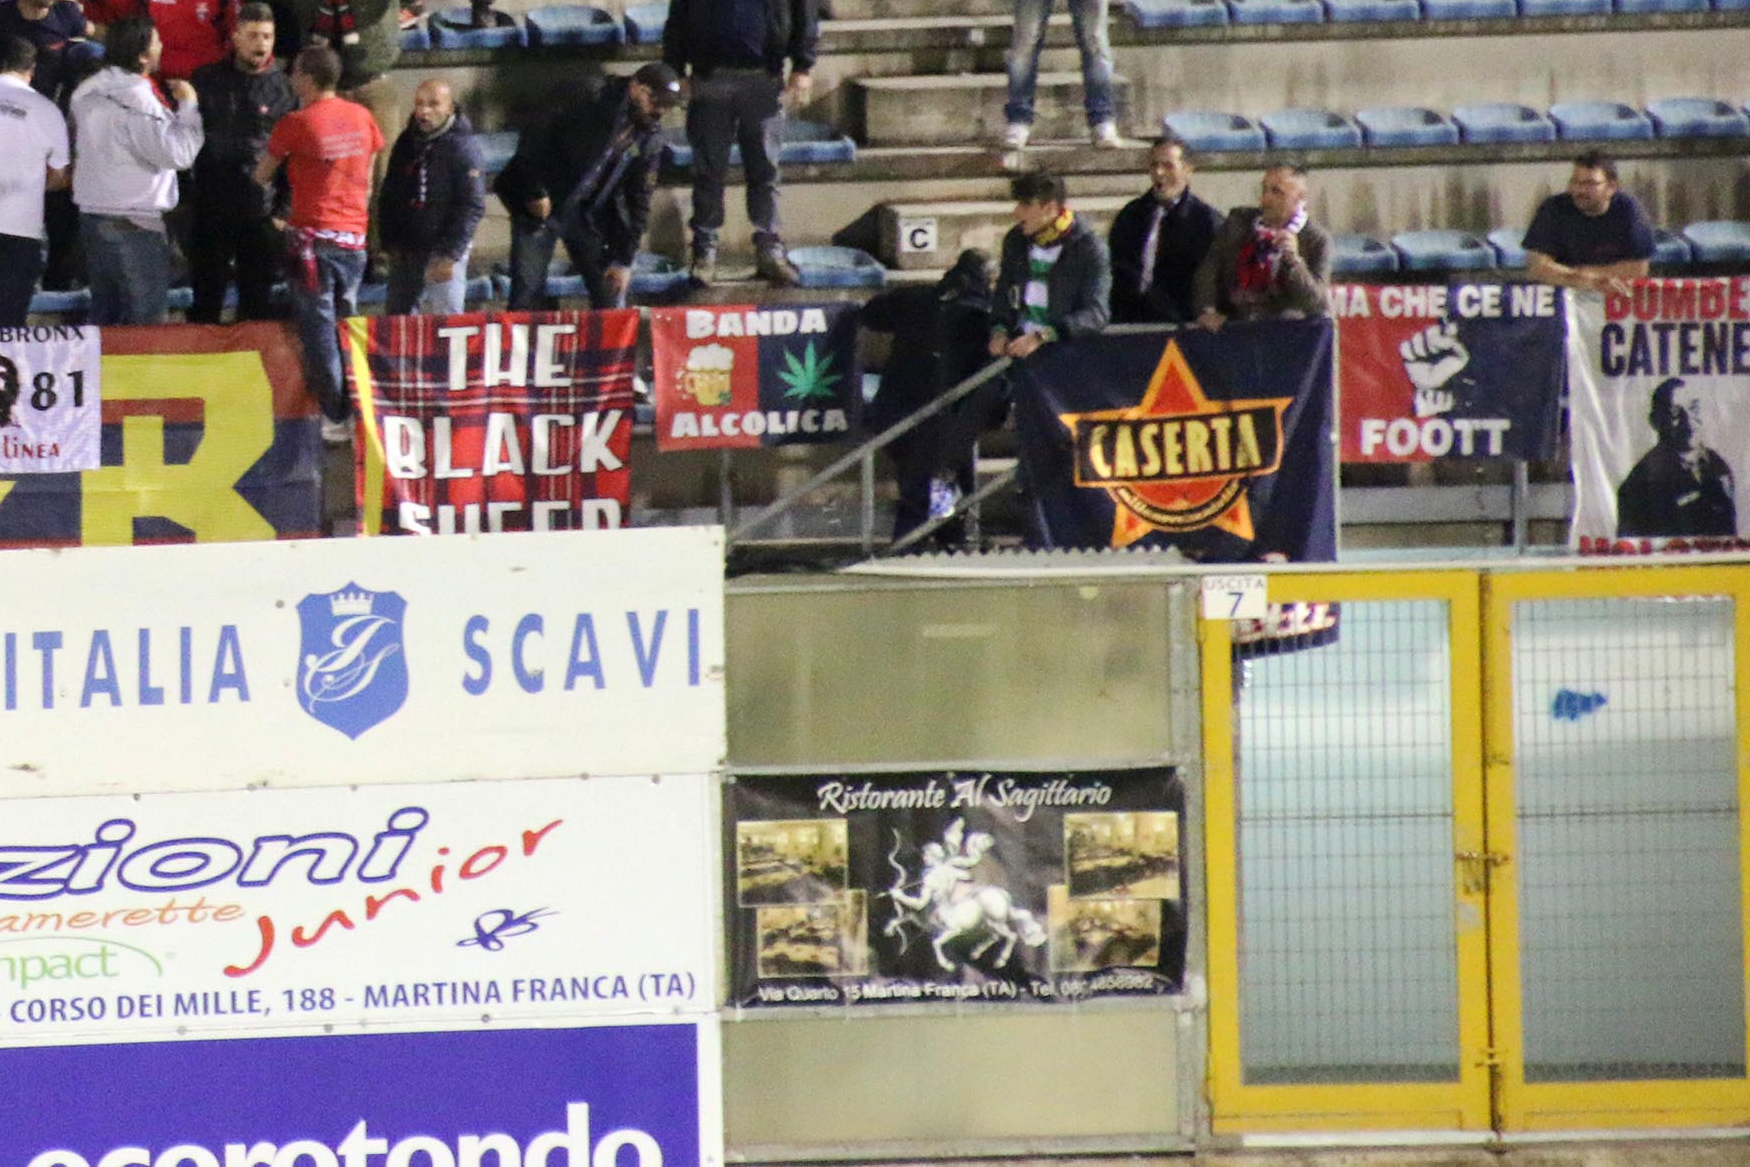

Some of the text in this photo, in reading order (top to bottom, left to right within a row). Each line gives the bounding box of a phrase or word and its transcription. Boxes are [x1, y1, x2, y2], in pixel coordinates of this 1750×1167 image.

[910, 228, 929, 249] C
[1325, 285, 1556, 319] MA CHE CE NE
[0, 325, 85, 343] BRONX
[686, 309, 827, 339] BANDA
[439, 323, 576, 391] THE
[1601, 321, 1750, 377] CATENE
[384, 409, 623, 480] BLACK
[671, 409, 848, 438] ALCOLICA
[1360, 418, 1512, 456] FOOTT
[1090, 413, 1262, 479] CASERTA
[1227, 591, 1244, 616] 7
[5, 624, 251, 711] ITALIA
[462, 608, 700, 696] SCAVI
[817, 774, 1113, 822] Ristorante Al Sagittario
[10, 997, 107, 1024] CORSO
[117, 995, 164, 1019] DEI
[173, 989, 272, 1019] MILLE,
[283, 987, 336, 1013] 188
[363, 980, 503, 1010] MARTINA
[511, 975, 630, 1002] FRANCA
[638, 971, 696, 1002] (TA)
